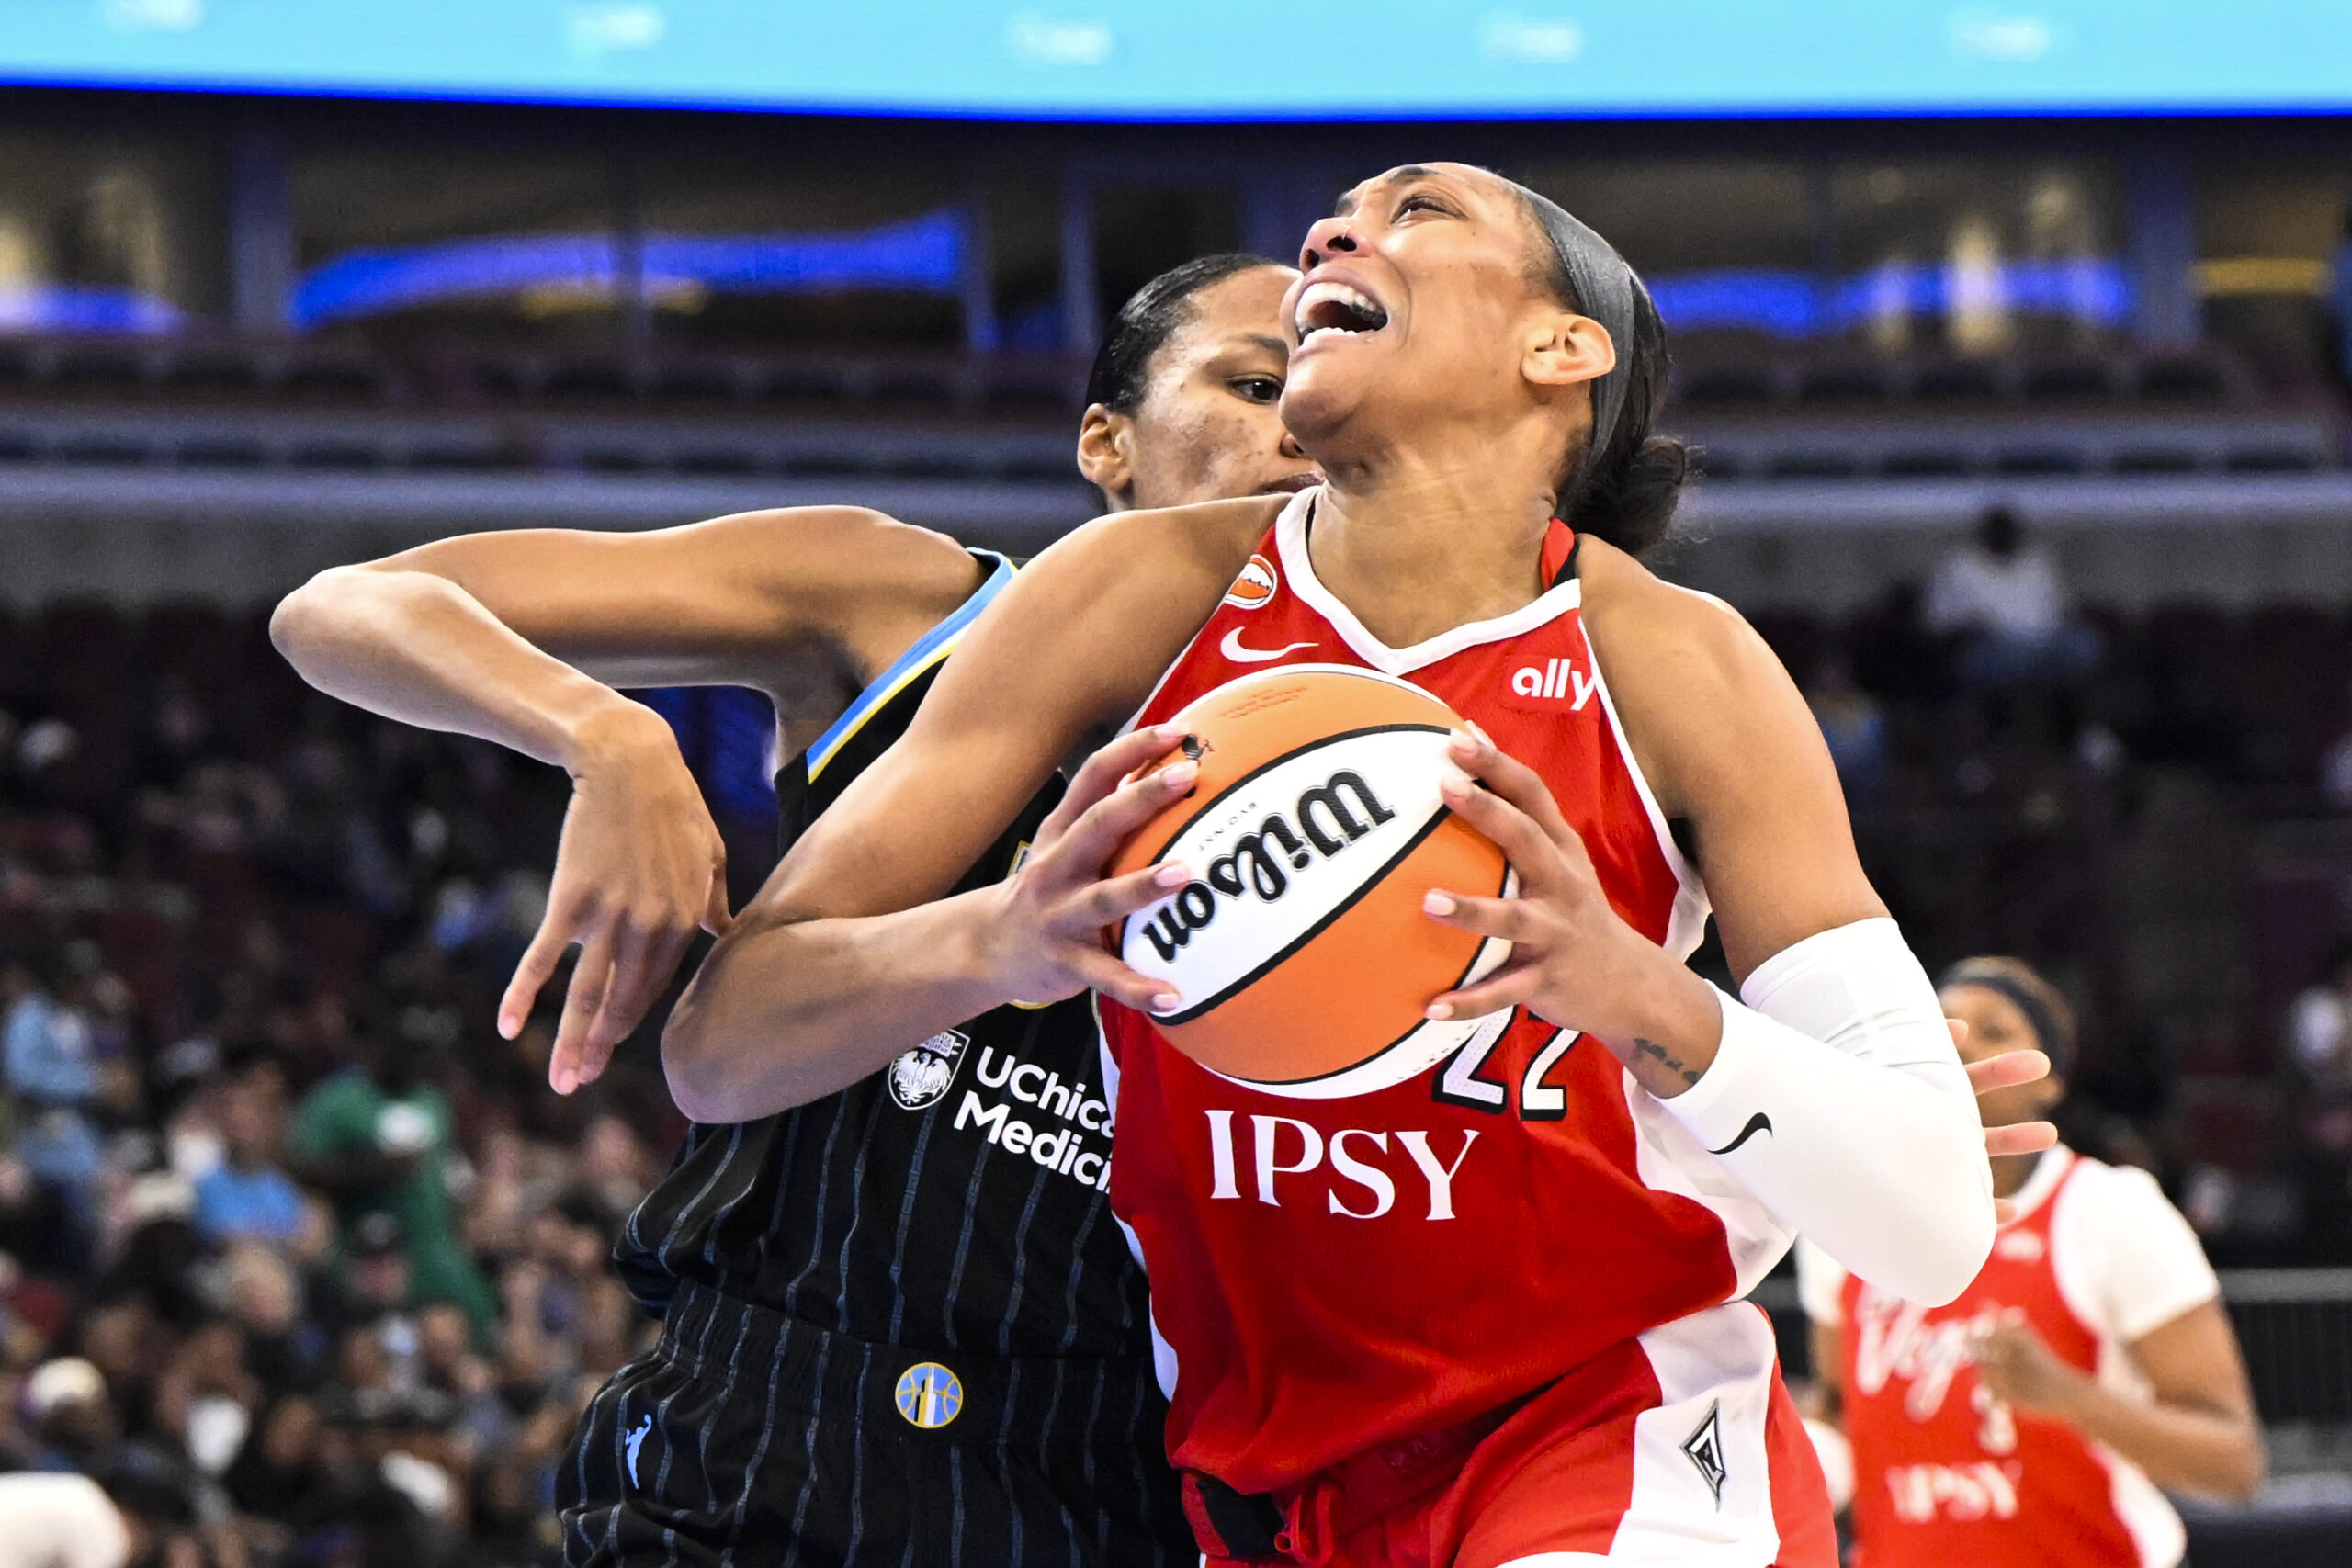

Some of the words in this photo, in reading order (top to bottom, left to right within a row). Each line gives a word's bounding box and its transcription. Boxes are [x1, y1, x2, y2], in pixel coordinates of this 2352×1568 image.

[1512, 659, 1594, 711] ally
[1142, 768, 1396, 964] Wilson
[1431, 1004, 1584, 1122] 22
[953, 1089, 1111, 1195] Medici
[1204, 1109, 1481, 1221] IPSY
